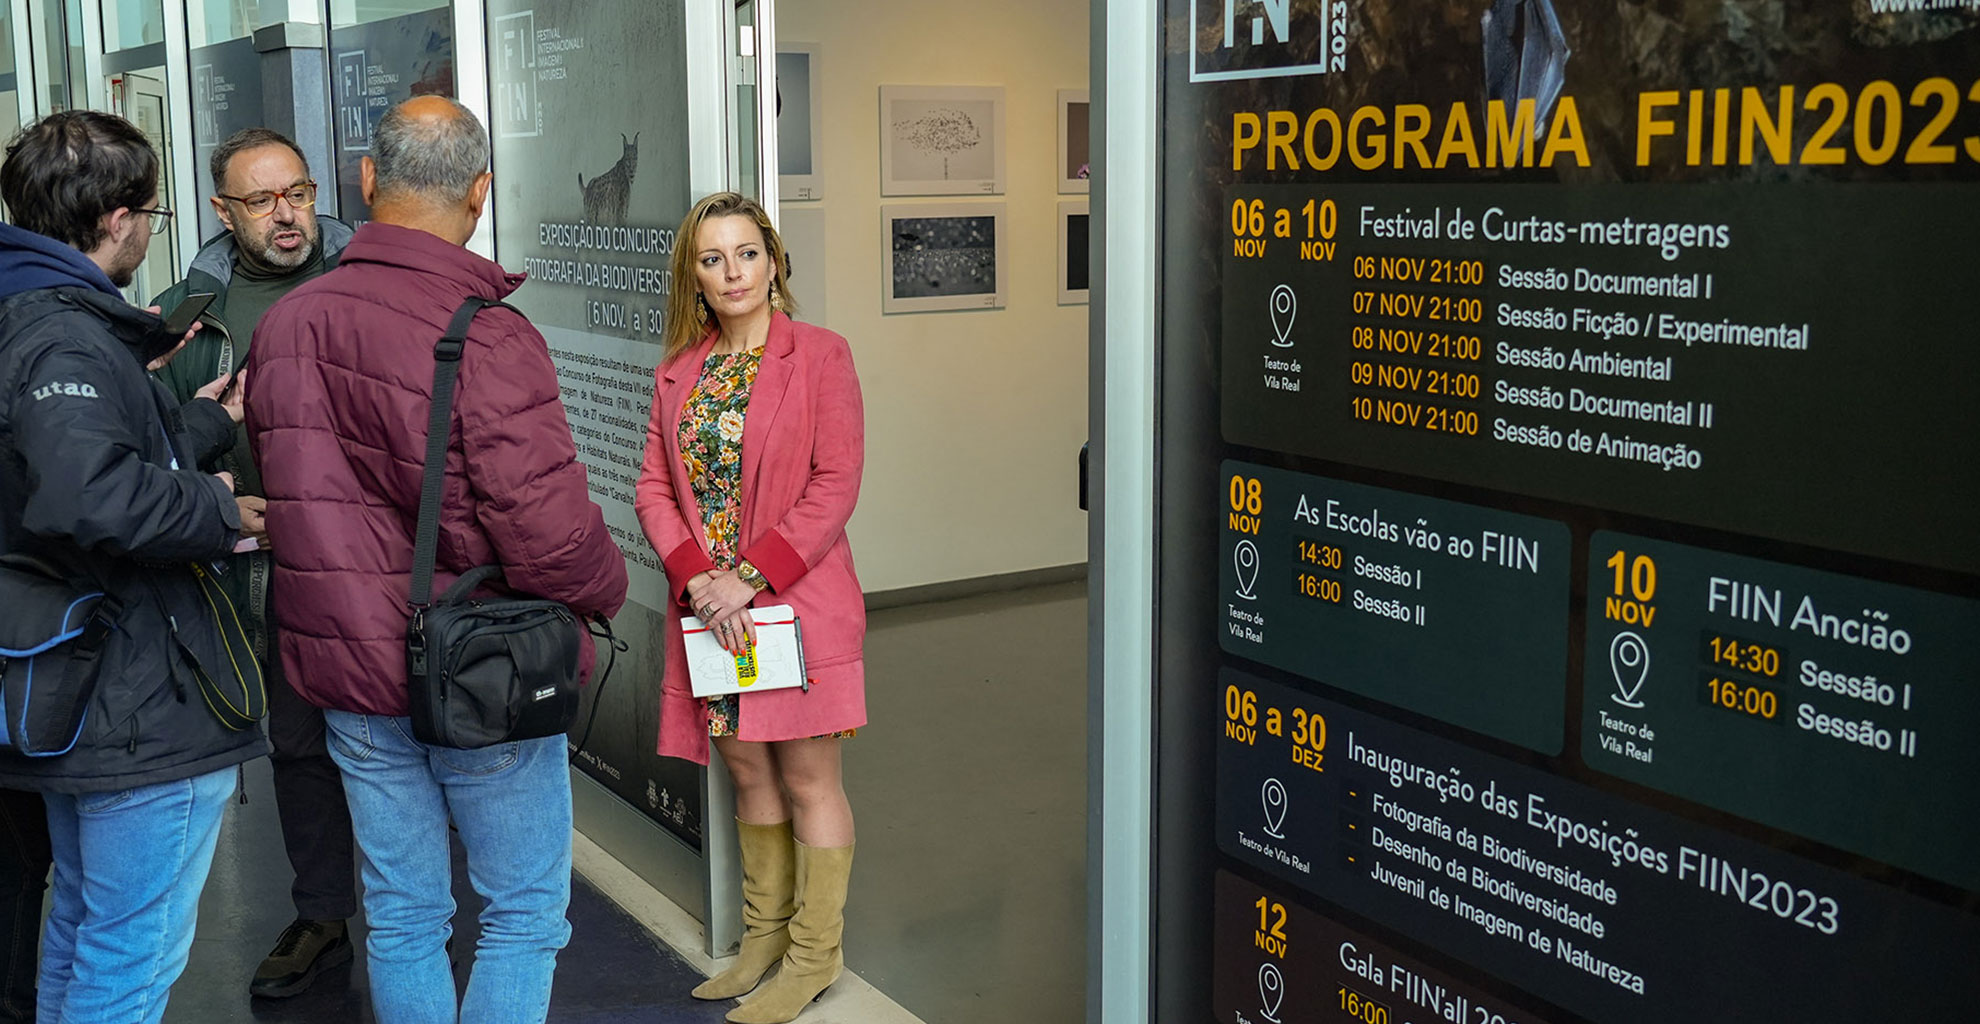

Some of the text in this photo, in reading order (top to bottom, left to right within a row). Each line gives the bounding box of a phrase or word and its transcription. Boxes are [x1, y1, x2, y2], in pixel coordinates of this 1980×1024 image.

[1331, 0, 1347, 73] 2023
[1232, 95, 1592, 171] PROGRAMA
[540, 220, 674, 255] EXPOSIÇÃO DO CONCURSO
[1232, 199, 1337, 239] 06 a 10
[1360, 206, 1730, 261] Festival de Curtas-metragens
[1234, 239, 1336, 261] NOV NOV
[1354, 256, 1483, 285] 06 NOV 21:00
[525, 257, 584, 286] FOTOGRAFIA
[585, 264, 600, 287] DA
[1498, 264, 1712, 299] Sessão Documental I
[602, 303, 626, 329] NOV.
[633, 313, 641, 331] a
[648, 309, 662, 334] 30
[1353, 291, 1482, 323] 07 NOV 21:00
[1497, 303, 1567, 331] Sessão
[1572, 308, 1640, 341] Ficção
[1659, 314, 1809, 350] Experimental
[1352, 326, 1481, 360] 08 NOV 21:00
[1496, 342, 1672, 381] Sessão Ambiental
[1263, 355, 1301, 373] Teatro de
[1264, 375, 1300, 392] Vila Real
[1351, 361, 1480, 398] 09 NOV 21:00
[1352, 397, 1479, 435] 10 NOV 21:00
[1494, 380, 1713, 429] Sessão Documental II
[1493, 418, 1702, 471] Sessão de Animação
[1230, 475, 1263, 516] 08
[1229, 512, 1261, 536] NOV
[1294, 494, 1539, 574] As Escolas vão ao FIIN
[1298, 540, 1421, 590] 14:30 Sessão I
[1606, 550, 1657, 602] 10
[1228, 603, 1264, 626] Teatro de
[1298, 573, 1425, 626] 16:00 Sessão II
[1605, 596, 1656, 628] NOV
[1708, 576, 1911, 655] FIIN Ancião
[1228, 622, 1263, 644] Vila Real
[1710, 636, 1911, 711] 14:30 Sessão I
[1225, 684, 1327, 752] 06 a 30
[1599, 710, 1655, 741] Teatro de
[1708, 677, 1916, 758] 16:00 Sessão II
[1225, 719, 1324, 772] NOV DEZ
[1599, 733, 1653, 764] Vila Real
[1238, 831, 1310, 874] Teatro de Vila Real
[1348, 731, 1839, 935] Inauguração das Exposições FIIN2023
[1373, 793, 1618, 906] Fotografia da Biodiversidade
[1372, 826, 1605, 938] Desenho da Biodiversidade
[1255, 896, 1287, 941] 12
[1371, 861, 1645, 995] Juvenil de Imagem de Natureza
[1255, 930, 1287, 959] NOV
[1339, 942, 1383, 987] Gala
[1338, 987, 1388, 1024] 16:00
